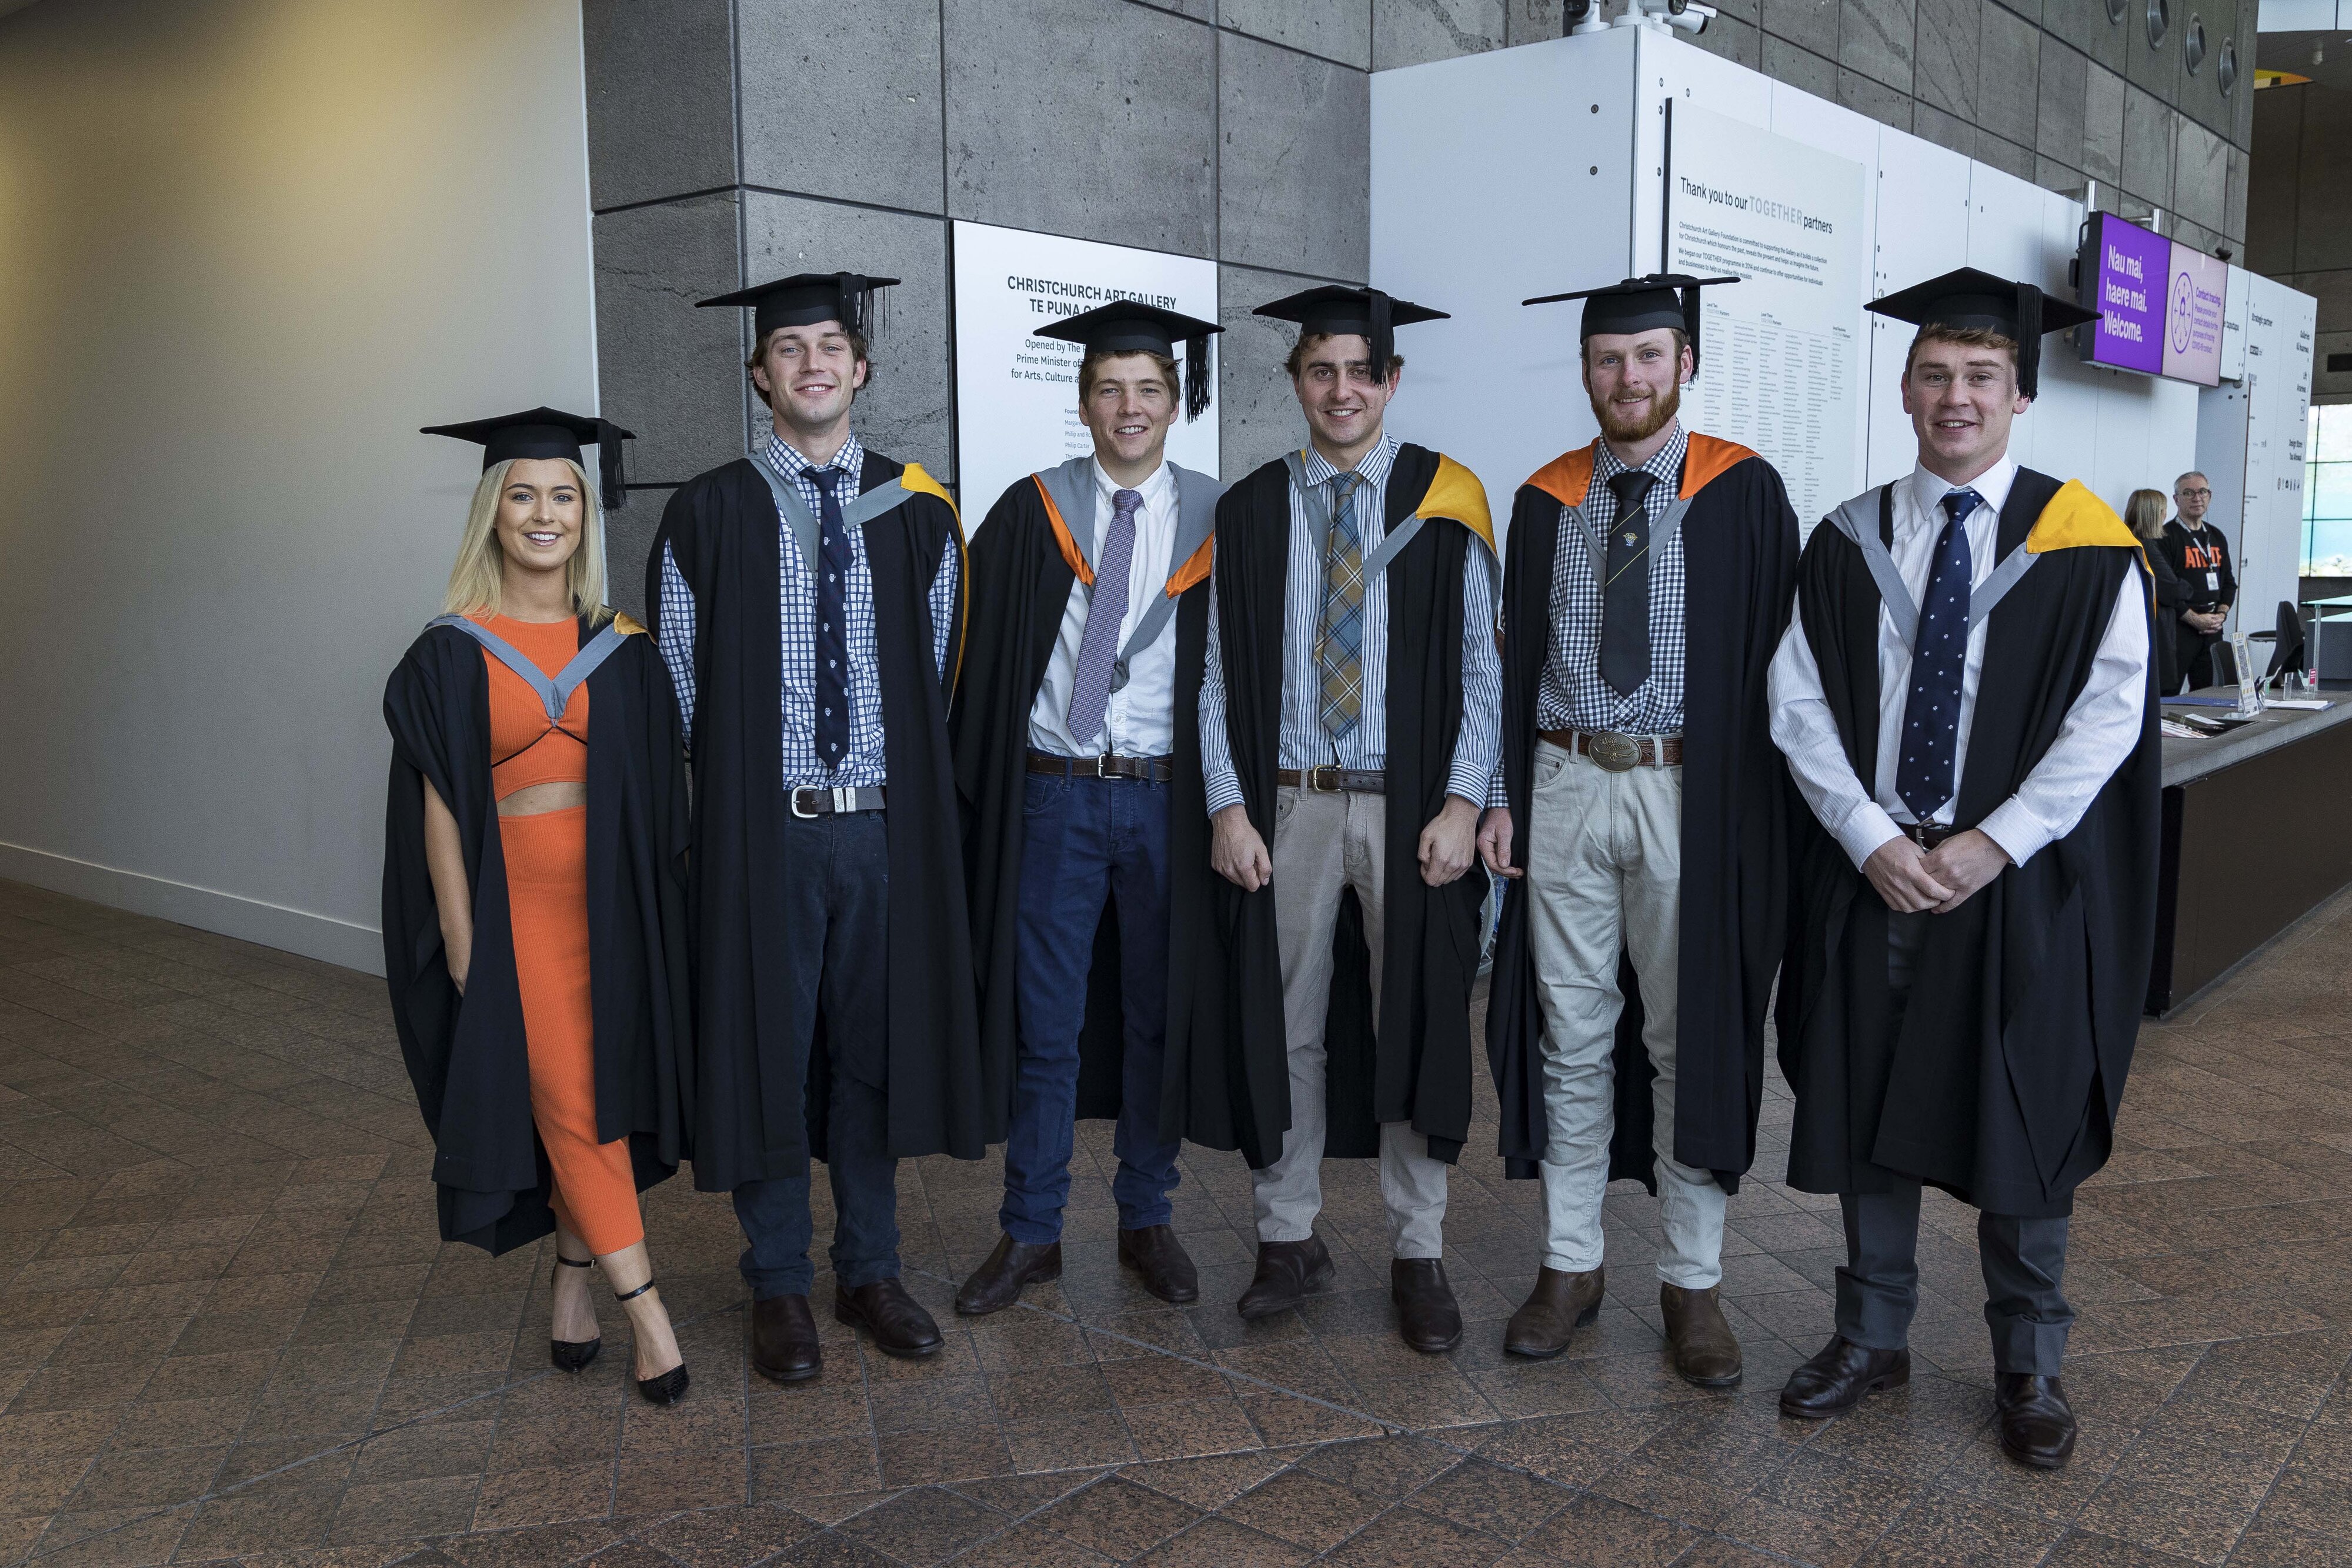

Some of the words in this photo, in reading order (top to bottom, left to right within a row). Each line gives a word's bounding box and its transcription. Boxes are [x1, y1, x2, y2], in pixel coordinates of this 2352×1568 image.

[1681, 177, 1707, 199] Thank
[1709, 189, 1723, 203] you
[1726, 191, 1733, 206] to
[1735, 197, 1748, 210] our
[1750, 195, 1802, 225] TOGETHER
[1804, 216, 1833, 234] partners
[1679, 221, 1702, 232] Christchurch
[1708, 228, 1720, 238] Gallery
[1721, 232, 1739, 242] Foundation
[1685, 233, 1706, 244] Christchurch
[1685, 249, 1696, 257] began
[1703, 252, 1722, 262] TOGETHER
[2108, 244, 2125, 274] Nau
[2127, 256, 2143, 284] mai,
[1686, 260, 1704, 270] businesses
[1008, 276, 1101, 300] CHRISTCHURCH
[1105, 289, 1126, 302] ART
[1129, 292, 1176, 309] GALLERY
[2106, 277, 2130, 307] haere
[2131, 289, 2147, 313] mai.
[1030, 298, 1043, 313] TE
[1048, 301, 1080, 316] PUNA
[2104, 309, 2143, 342] Welcome.
[1026, 339, 1055, 351] Opened
[1057, 342, 1065, 353] by
[1067, 343, 1080, 353] The
[1017, 354, 1039, 364] Prime
[1041, 356, 1071, 367] Minister
[1073, 359, 1080, 368] of
[1012, 369, 1022, 379] for
[1025, 371, 1043, 381] Arts,
[1046, 372, 1073, 383] Culture
